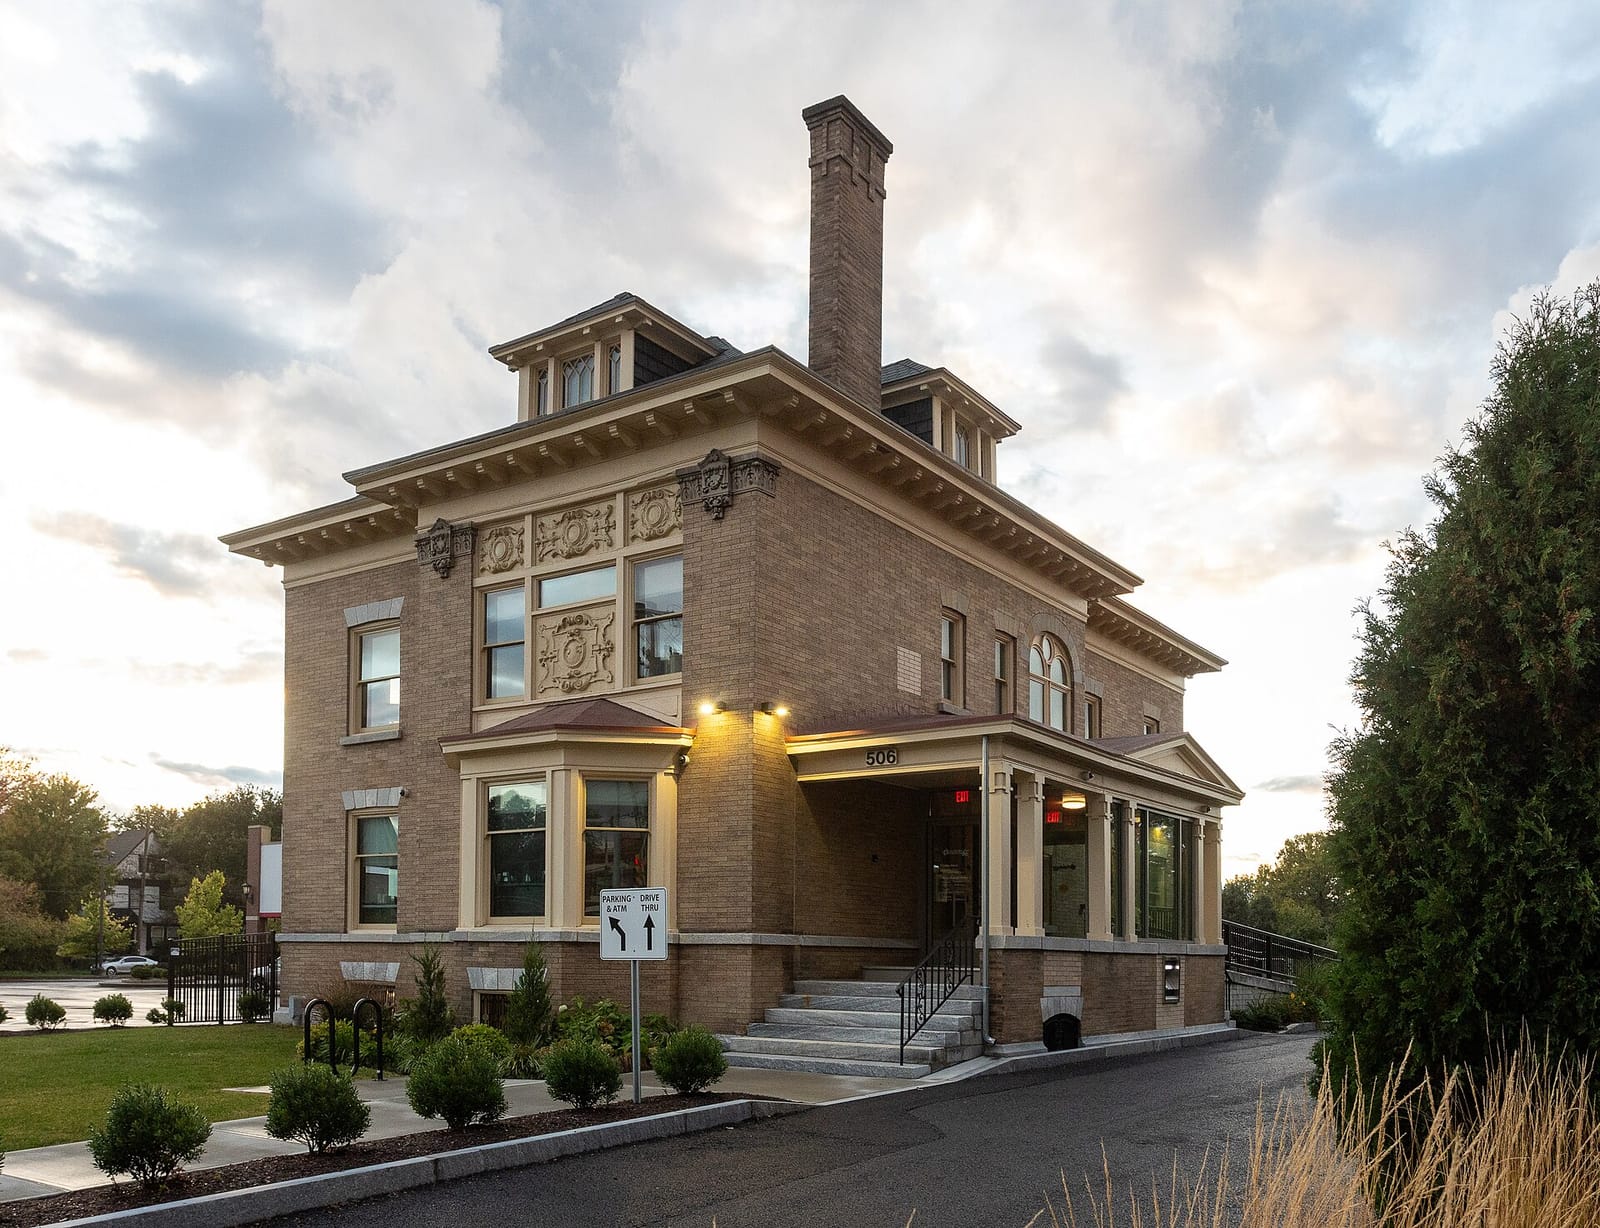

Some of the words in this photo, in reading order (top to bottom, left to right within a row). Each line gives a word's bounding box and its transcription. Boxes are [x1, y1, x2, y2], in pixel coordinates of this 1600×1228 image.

[866, 750, 896, 765] 506
[956, 791, 969, 803] EXIT
[1047, 812, 1059, 823] EXIT
[602, 894, 632, 903] PARKING
[640, 893, 660, 902] DRIVE
[606, 904, 612, 913] &
[612, 904, 628, 913] ATM
[641, 904, 659, 912] THRU
